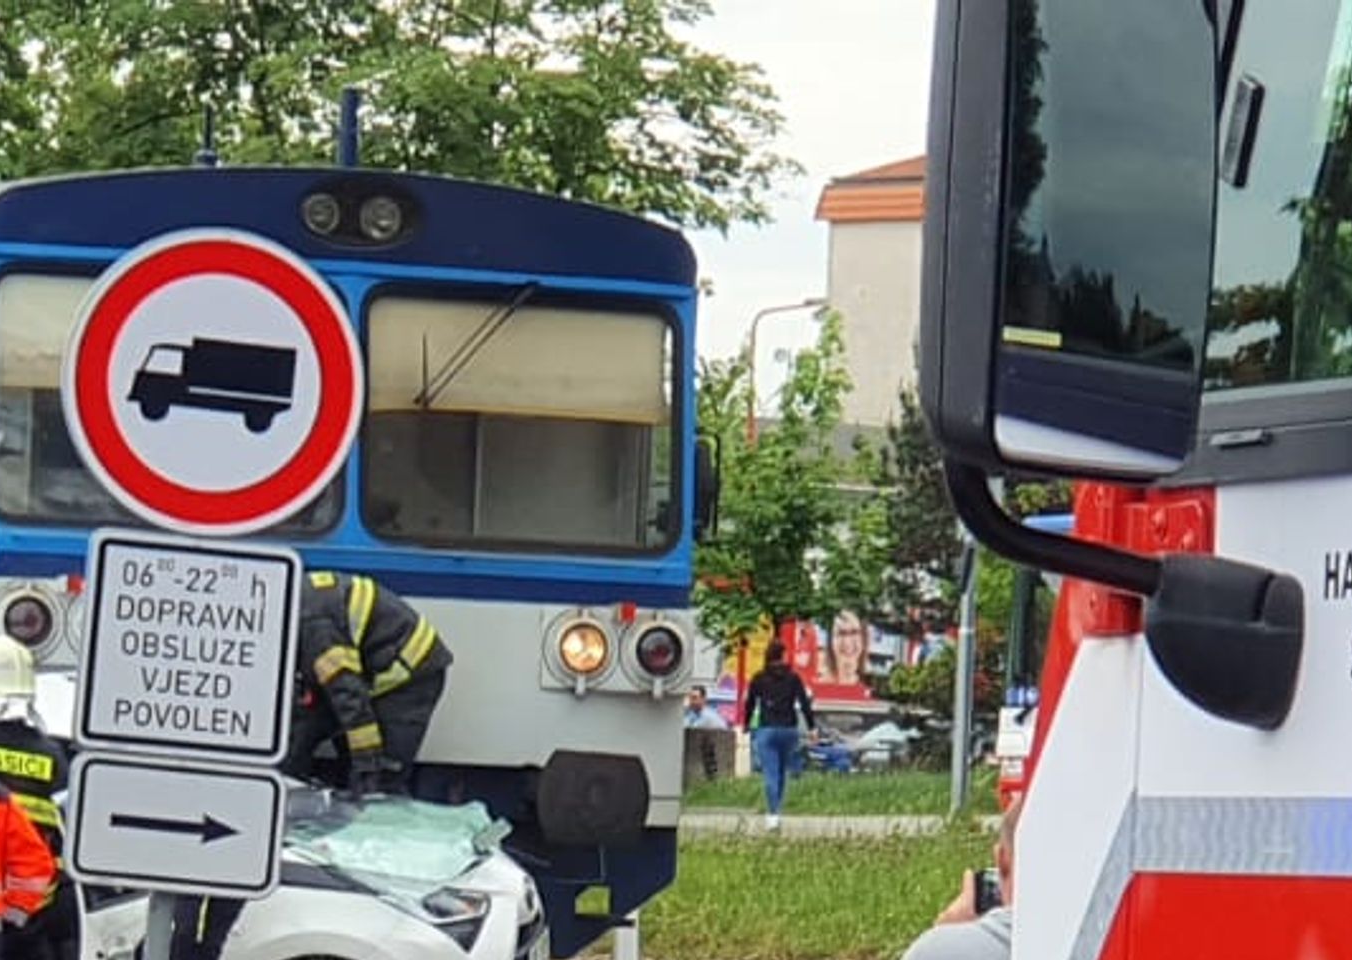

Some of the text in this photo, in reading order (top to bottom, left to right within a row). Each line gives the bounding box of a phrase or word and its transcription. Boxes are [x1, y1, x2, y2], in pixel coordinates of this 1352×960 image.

[251, 573, 267, 599] h
[115, 594, 266, 634] DOPRAVNÍ
[121, 629, 256, 668] OBSLUZE
[140, 666, 232, 700] VJEZD
[114, 699, 252, 737] POVOLEN
